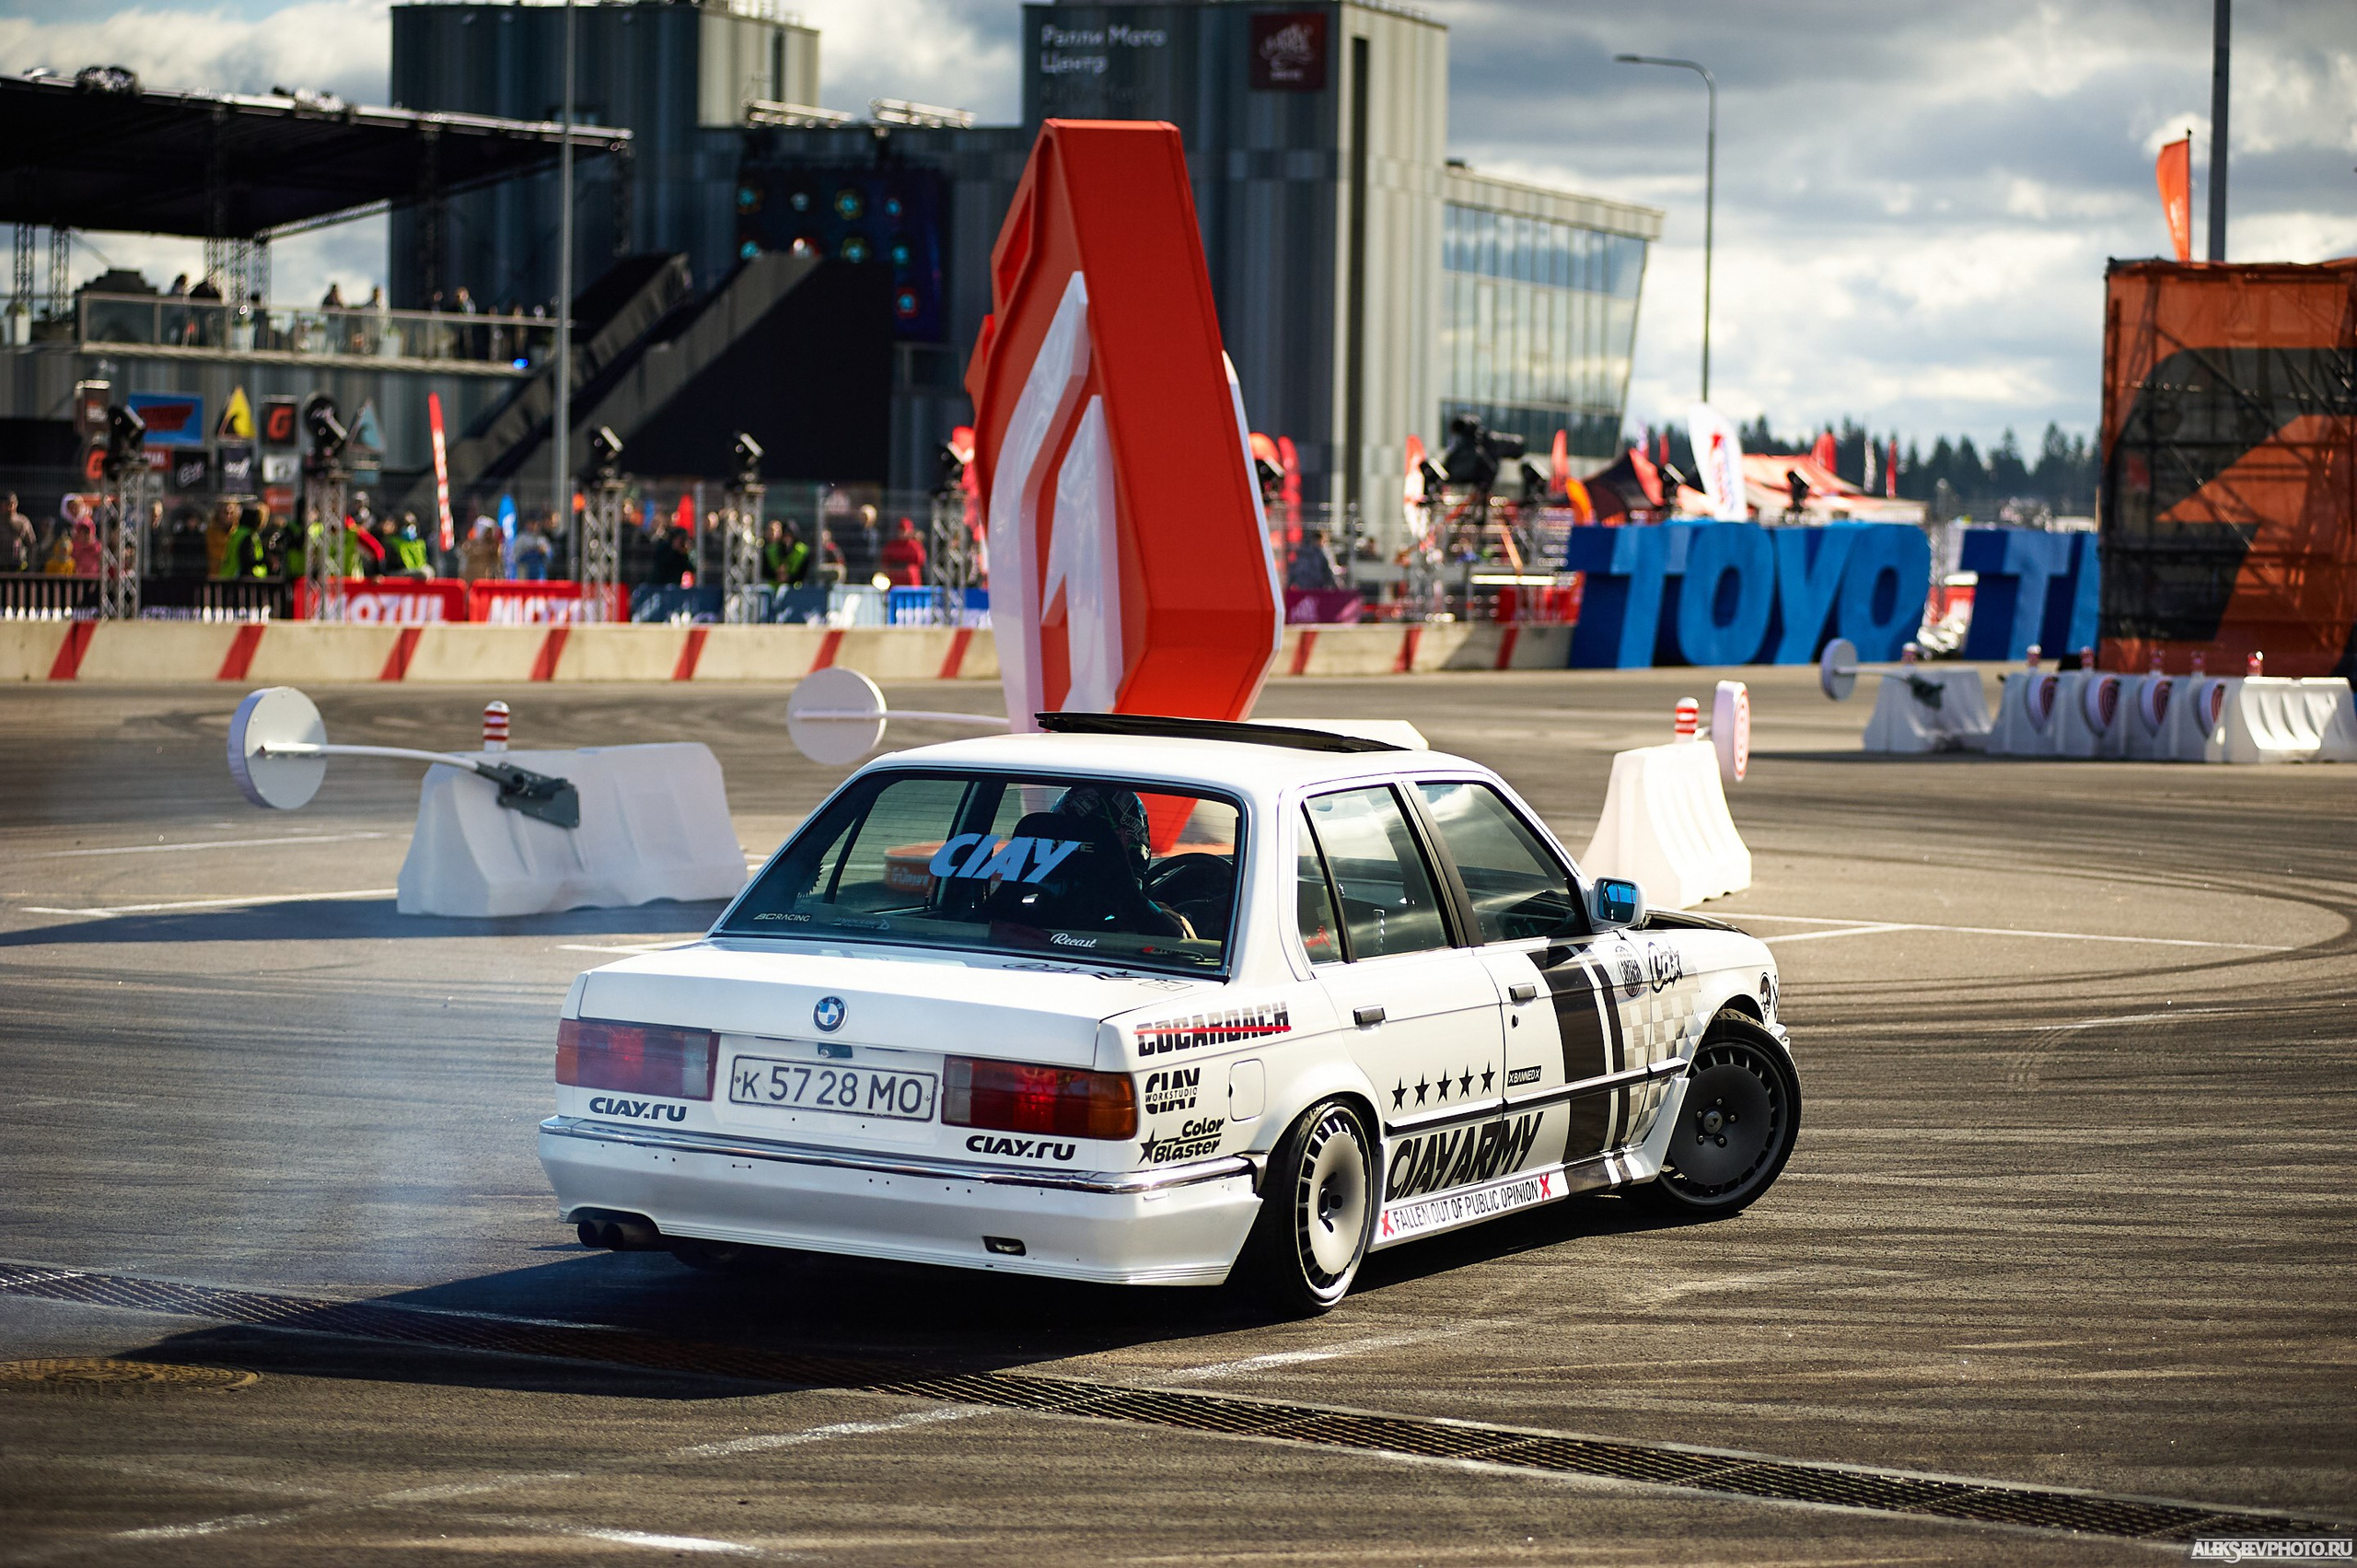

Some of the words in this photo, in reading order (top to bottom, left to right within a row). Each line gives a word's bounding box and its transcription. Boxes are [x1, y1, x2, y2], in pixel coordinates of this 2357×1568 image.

[1608, 521, 1931, 668] TOYO
[1050, 933, 1098, 948] Recast
[1181, 1117, 1225, 1139] Color
[1154, 1138, 1221, 1164] Blaster
[1393, 1203, 1429, 1231] FALLEN
[1429, 1201, 1450, 1223] OUT
[1451, 1195, 1463, 1218] OF
[1466, 1187, 1500, 1217] PUBLIC
[1502, 1179, 1538, 1207] OPINION
